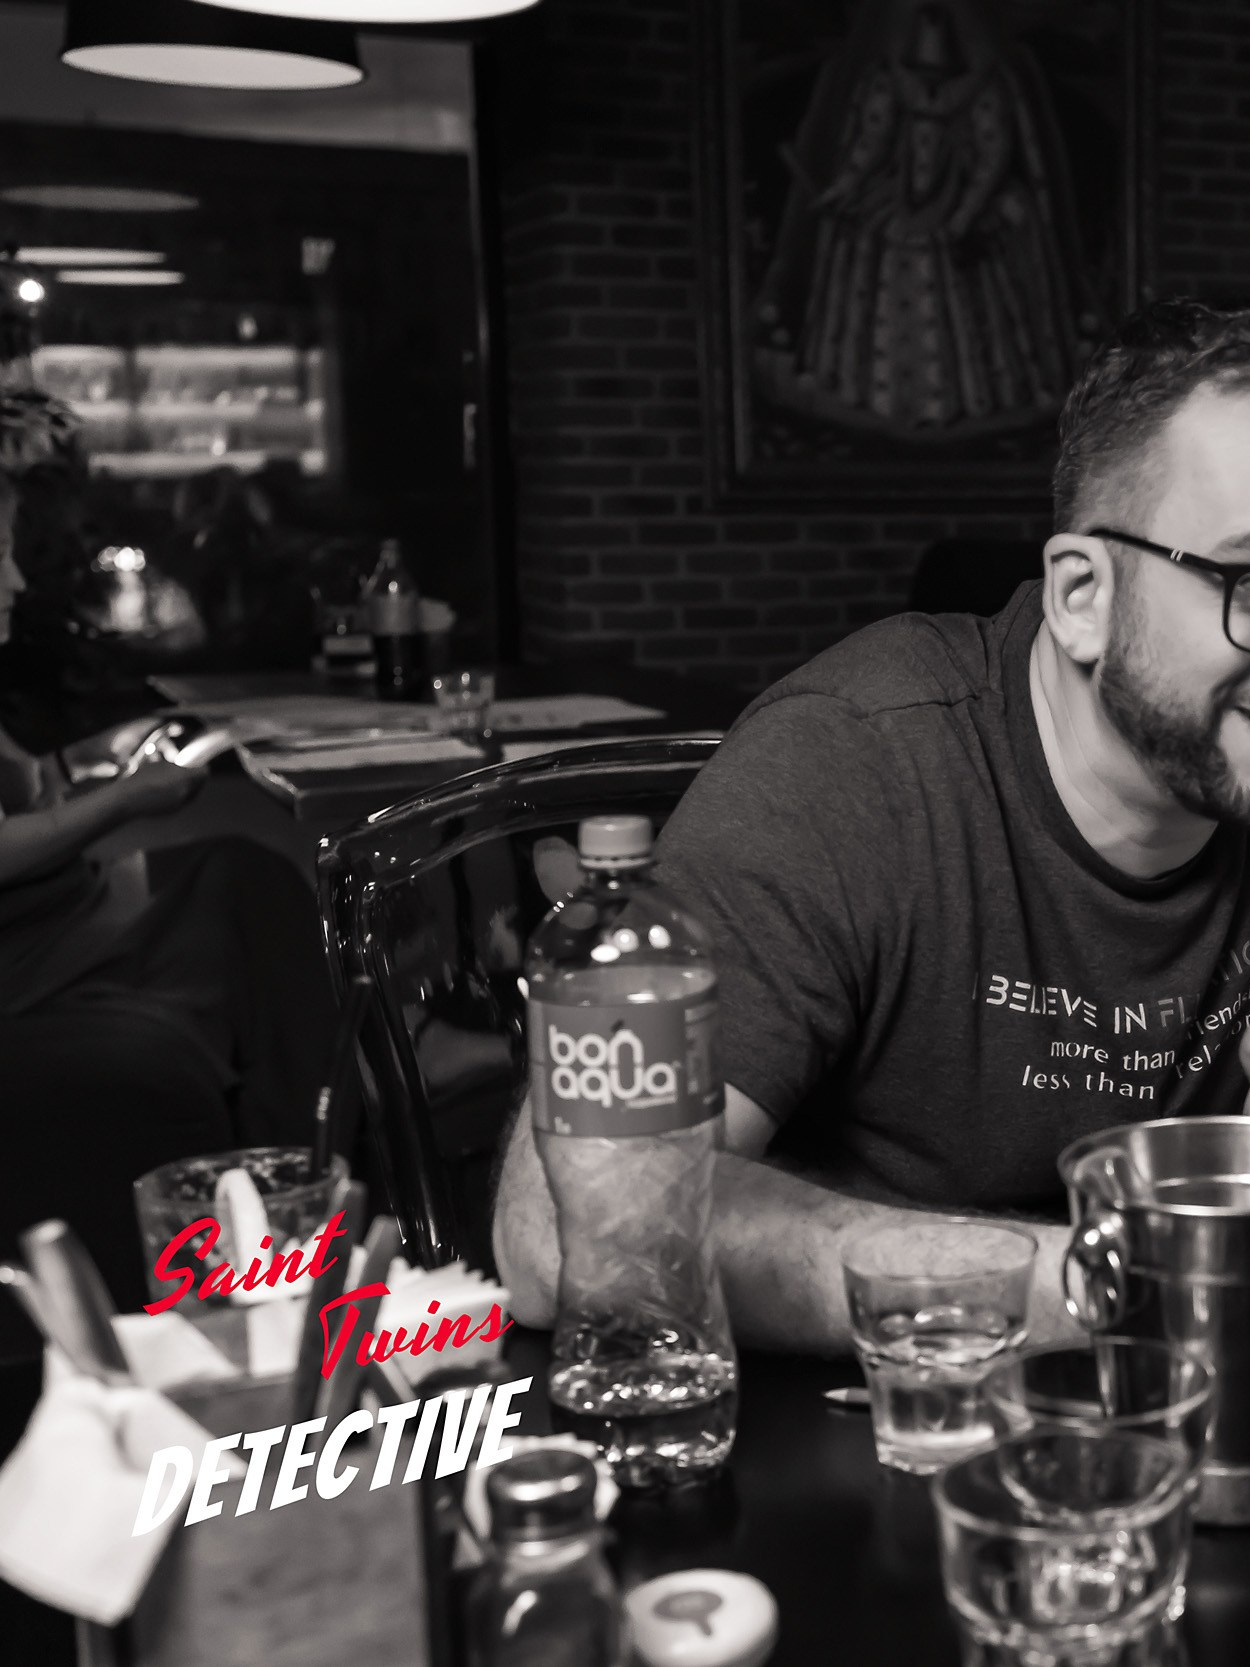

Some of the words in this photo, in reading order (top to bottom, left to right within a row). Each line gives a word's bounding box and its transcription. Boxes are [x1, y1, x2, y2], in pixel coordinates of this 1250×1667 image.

[1114, 1002, 1147, 1034] IN
[1050, 1040, 1109, 1064] more
[1122, 1049, 1175, 1071] than
[551, 1062, 678, 1108] aqua
[1021, 1064, 1070, 1090] less
[1086, 1071, 1154, 1100] than
